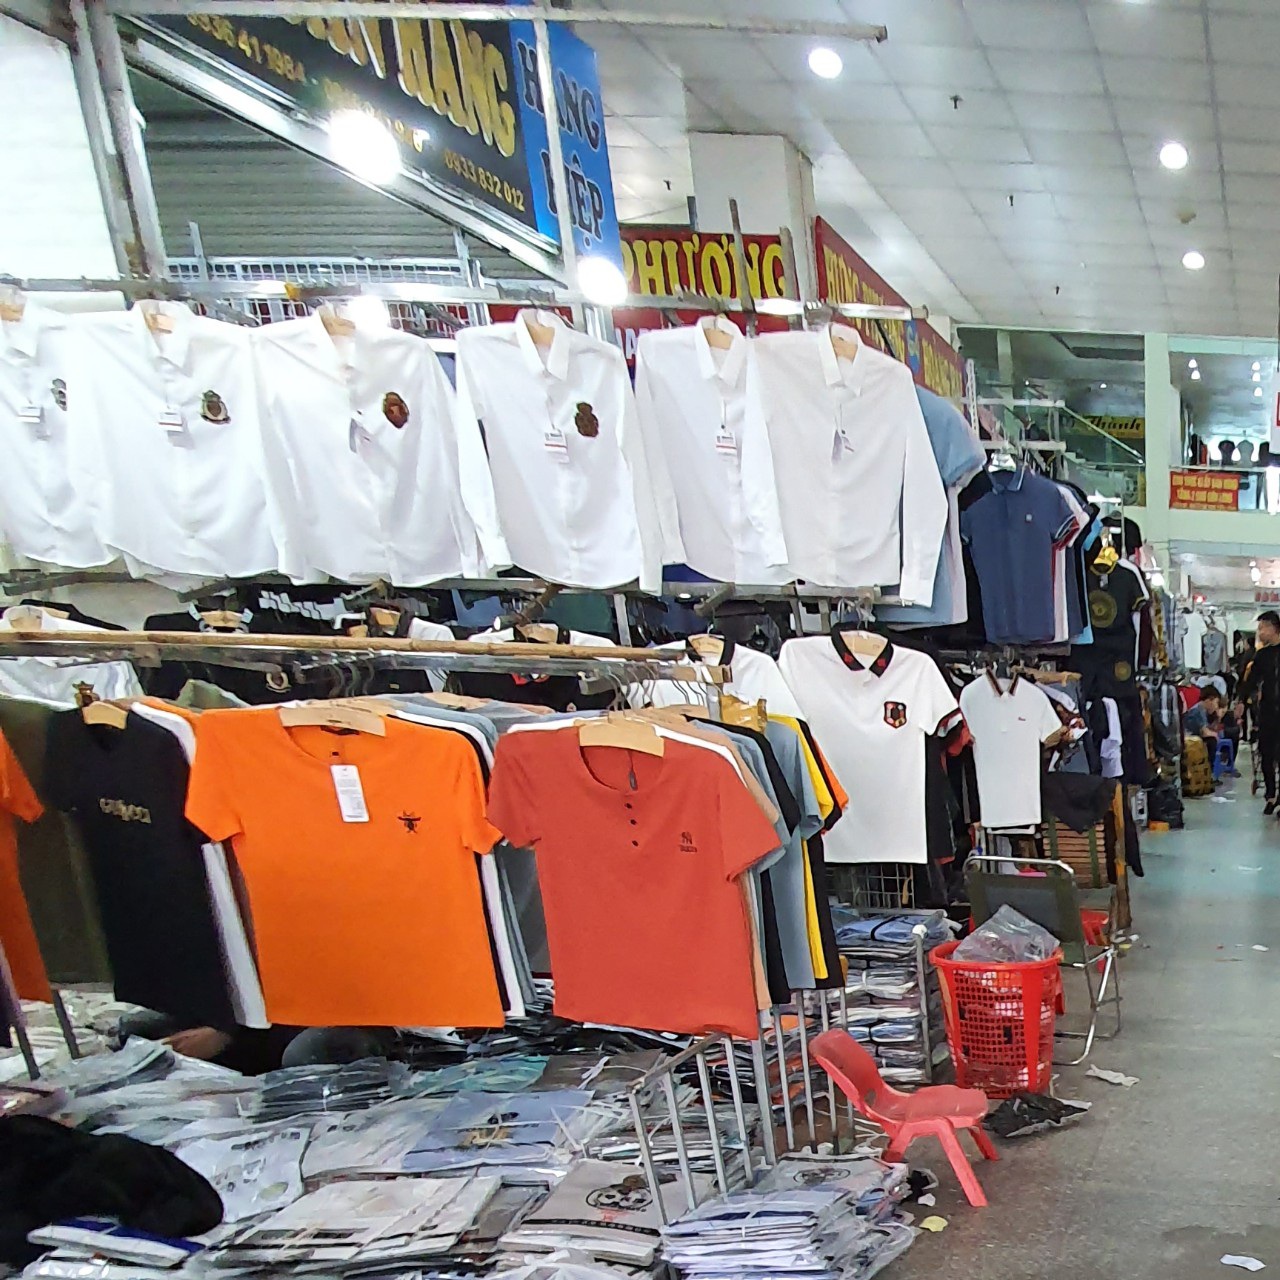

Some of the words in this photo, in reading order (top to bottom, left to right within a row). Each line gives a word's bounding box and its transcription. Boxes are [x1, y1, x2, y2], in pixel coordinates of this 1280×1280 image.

[515, 38, 600, 151] HNG
[478, 166, 503, 199] 832
[503, 180, 525, 212] 012
